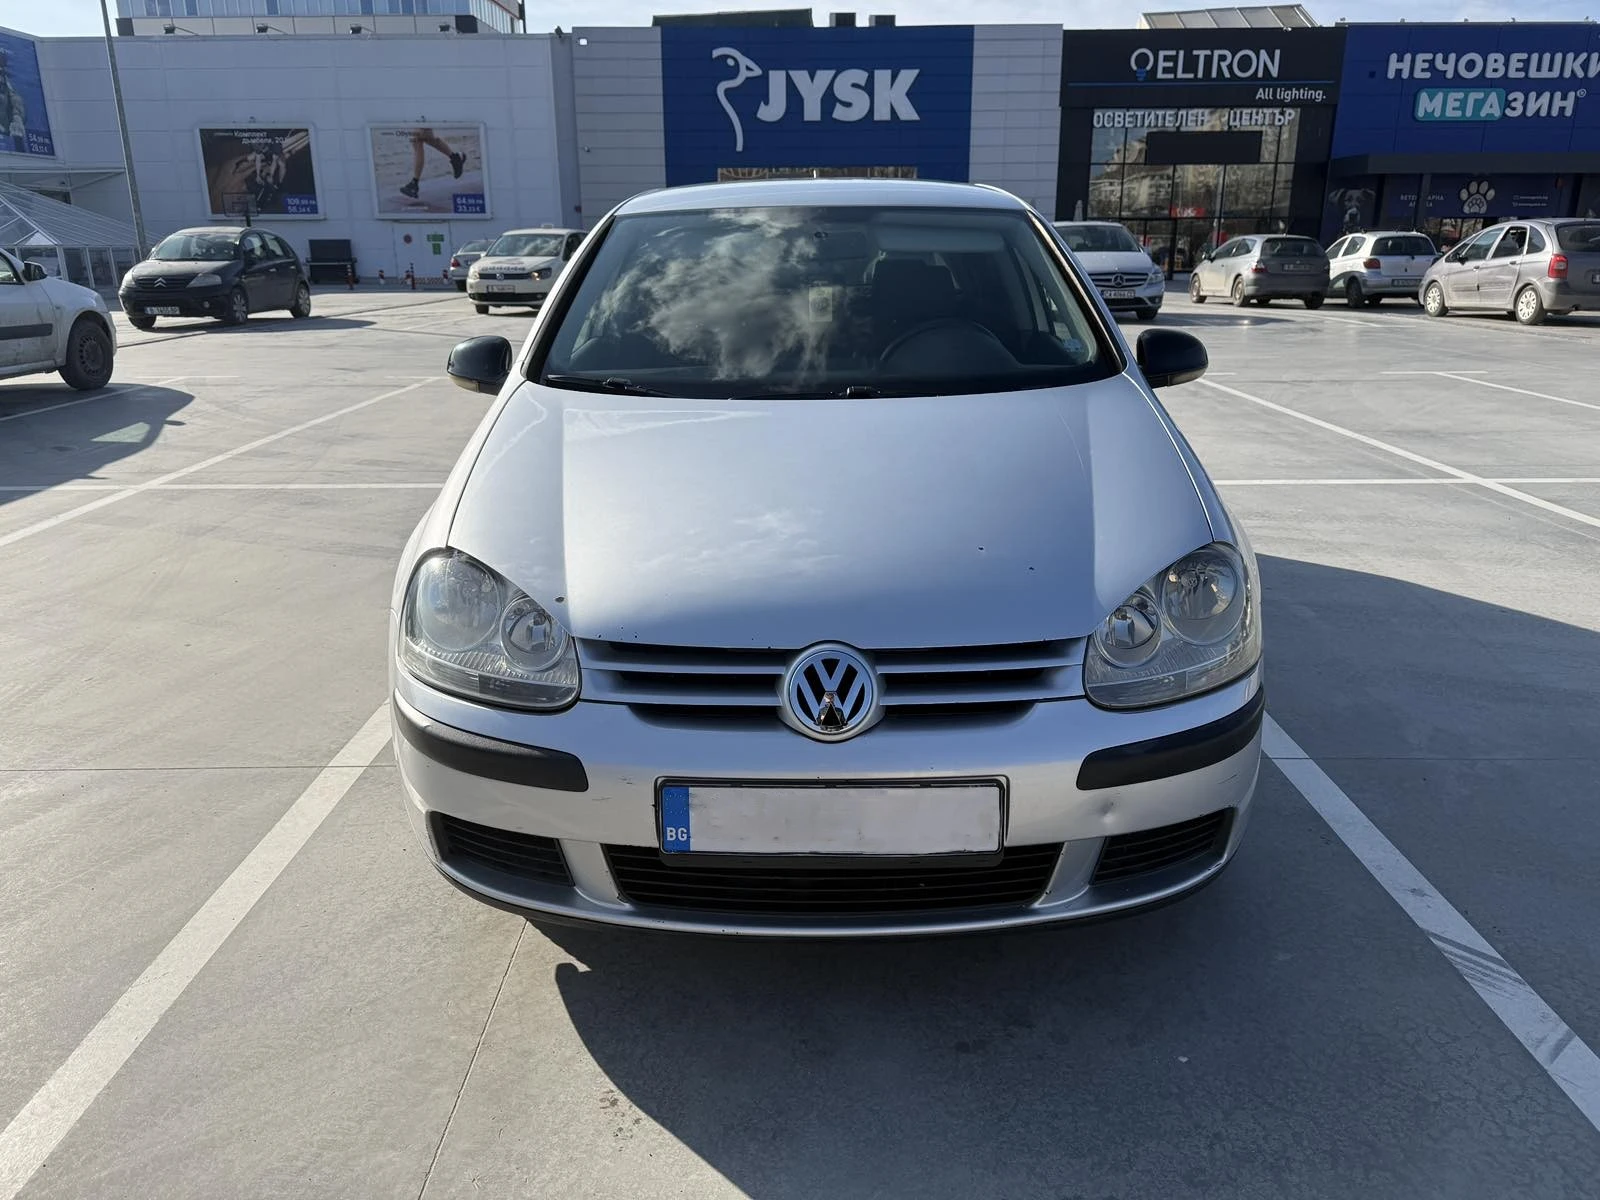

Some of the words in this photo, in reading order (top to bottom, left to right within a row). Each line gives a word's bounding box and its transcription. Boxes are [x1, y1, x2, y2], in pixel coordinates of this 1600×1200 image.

[756, 68, 920, 122] JYSK
[1256, 87, 1273, 100] All
[1276, 87, 1327, 102] lighting.
[1093, 107, 1208, 128] ОСВЕТИТЕЛЕН
[1229, 109, 1296, 127] ЦЕНТЪР
[666, 827, 688, 841] BG
